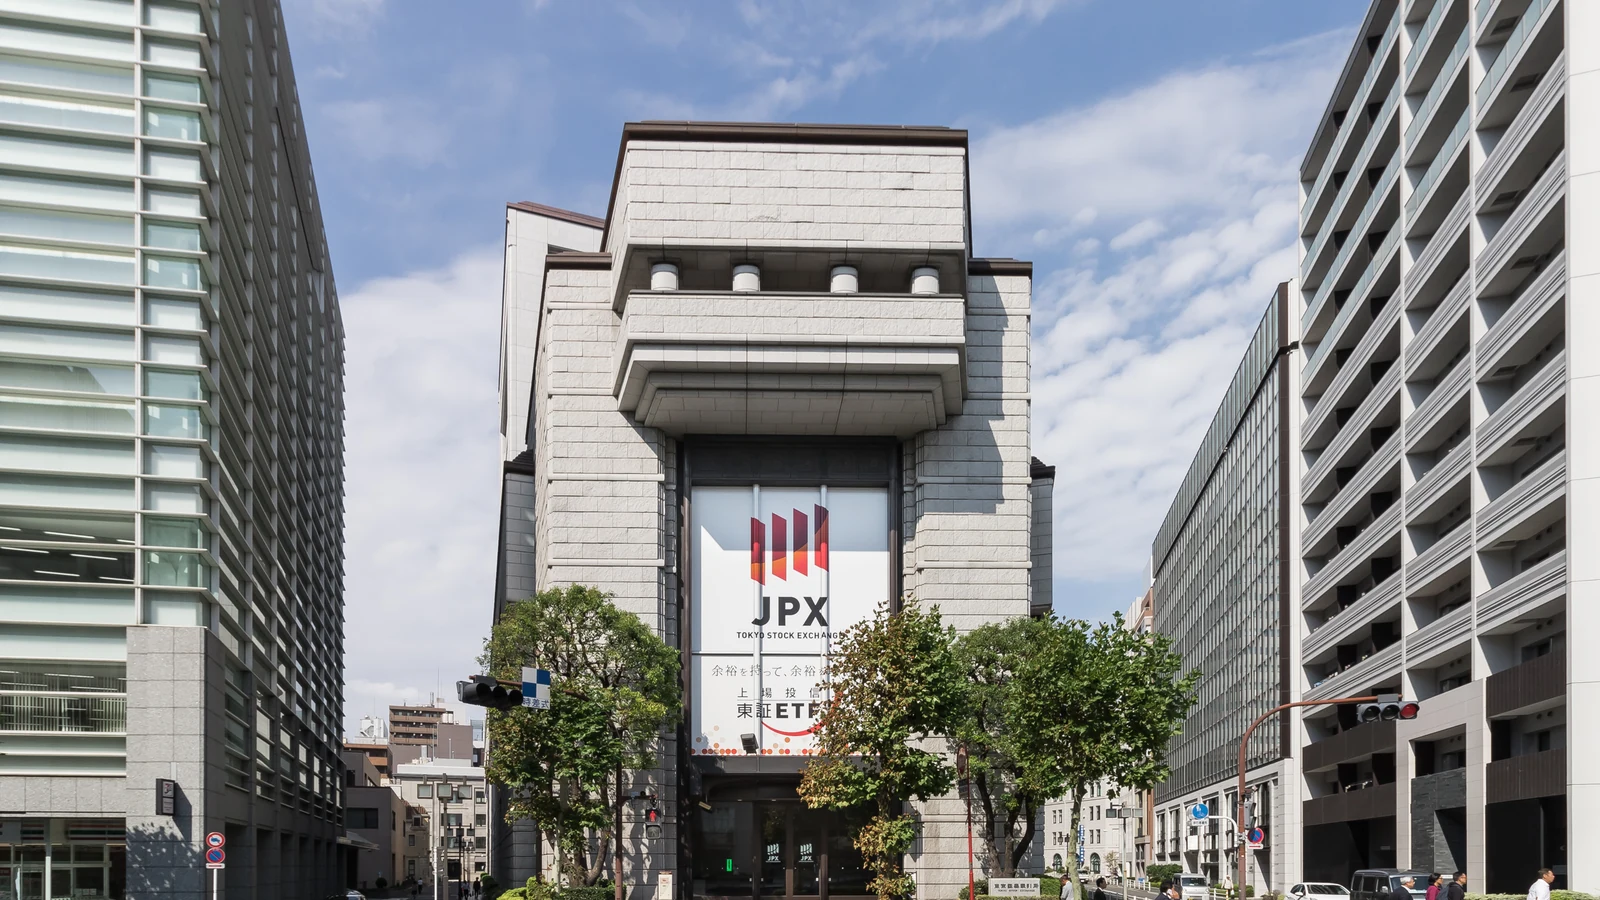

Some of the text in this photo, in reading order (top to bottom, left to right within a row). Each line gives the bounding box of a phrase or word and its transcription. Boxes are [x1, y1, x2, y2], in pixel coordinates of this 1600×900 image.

[751, 596, 829, 627] JPX
[767, 631, 795, 639] STOCK
[737, 687, 820, 699] 上場投信
[522, 698, 549, 708] 時差式
